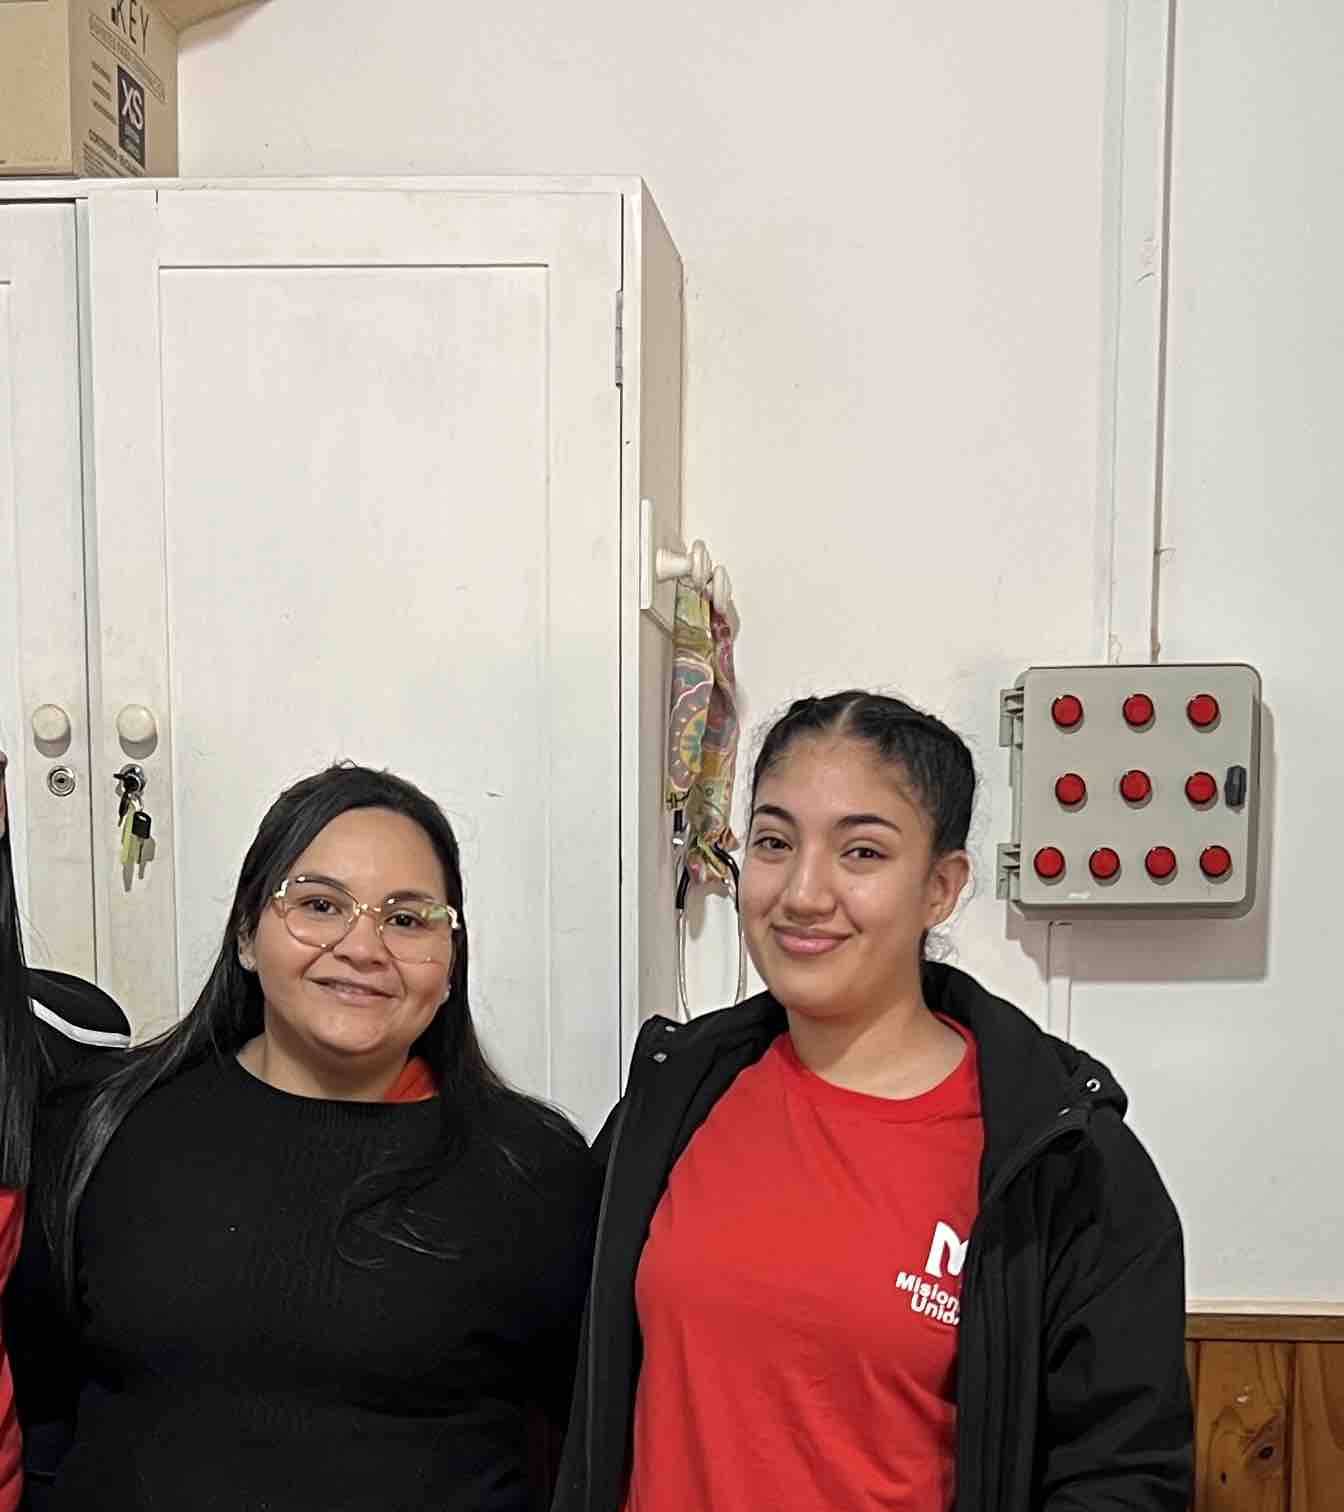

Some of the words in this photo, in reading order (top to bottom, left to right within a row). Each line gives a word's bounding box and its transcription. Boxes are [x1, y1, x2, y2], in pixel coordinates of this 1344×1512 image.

[121, 79, 144, 131] XS
[895, 1271, 960, 1312] Mision
[911, 1293, 960, 1326] Unid
